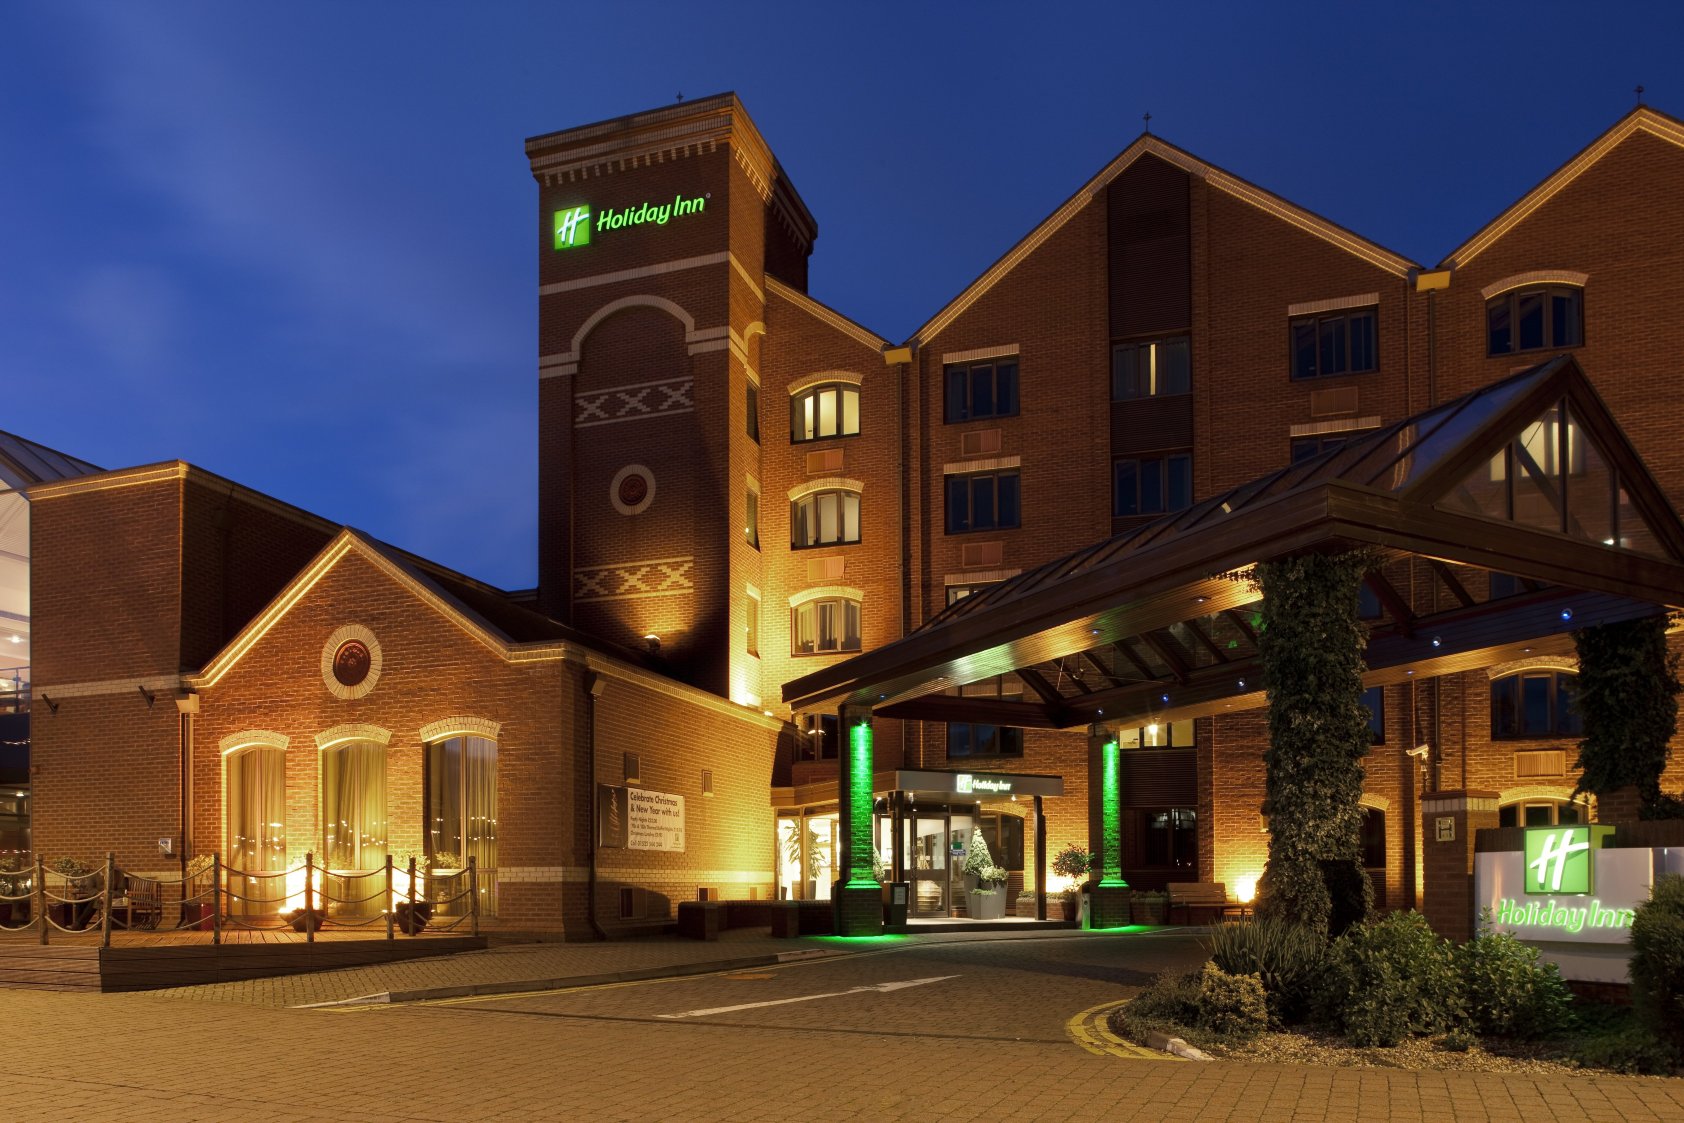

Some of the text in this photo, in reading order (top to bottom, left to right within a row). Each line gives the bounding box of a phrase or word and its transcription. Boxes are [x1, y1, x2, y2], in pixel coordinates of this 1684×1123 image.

[596, 202, 671, 232] Holiday
[673, 195, 705, 217] Inn
[972, 779, 999, 792] Holiday
[999, 780, 1012, 791] Inn
[630, 792, 678, 806] Celebrate Christmas
[630, 803, 635, 812] &
[636, 804, 649, 813] New
[649, 805, 661, 815] Year
[661, 807, 672, 816] with
[1497, 899, 1636, 934] Holiday Inn
